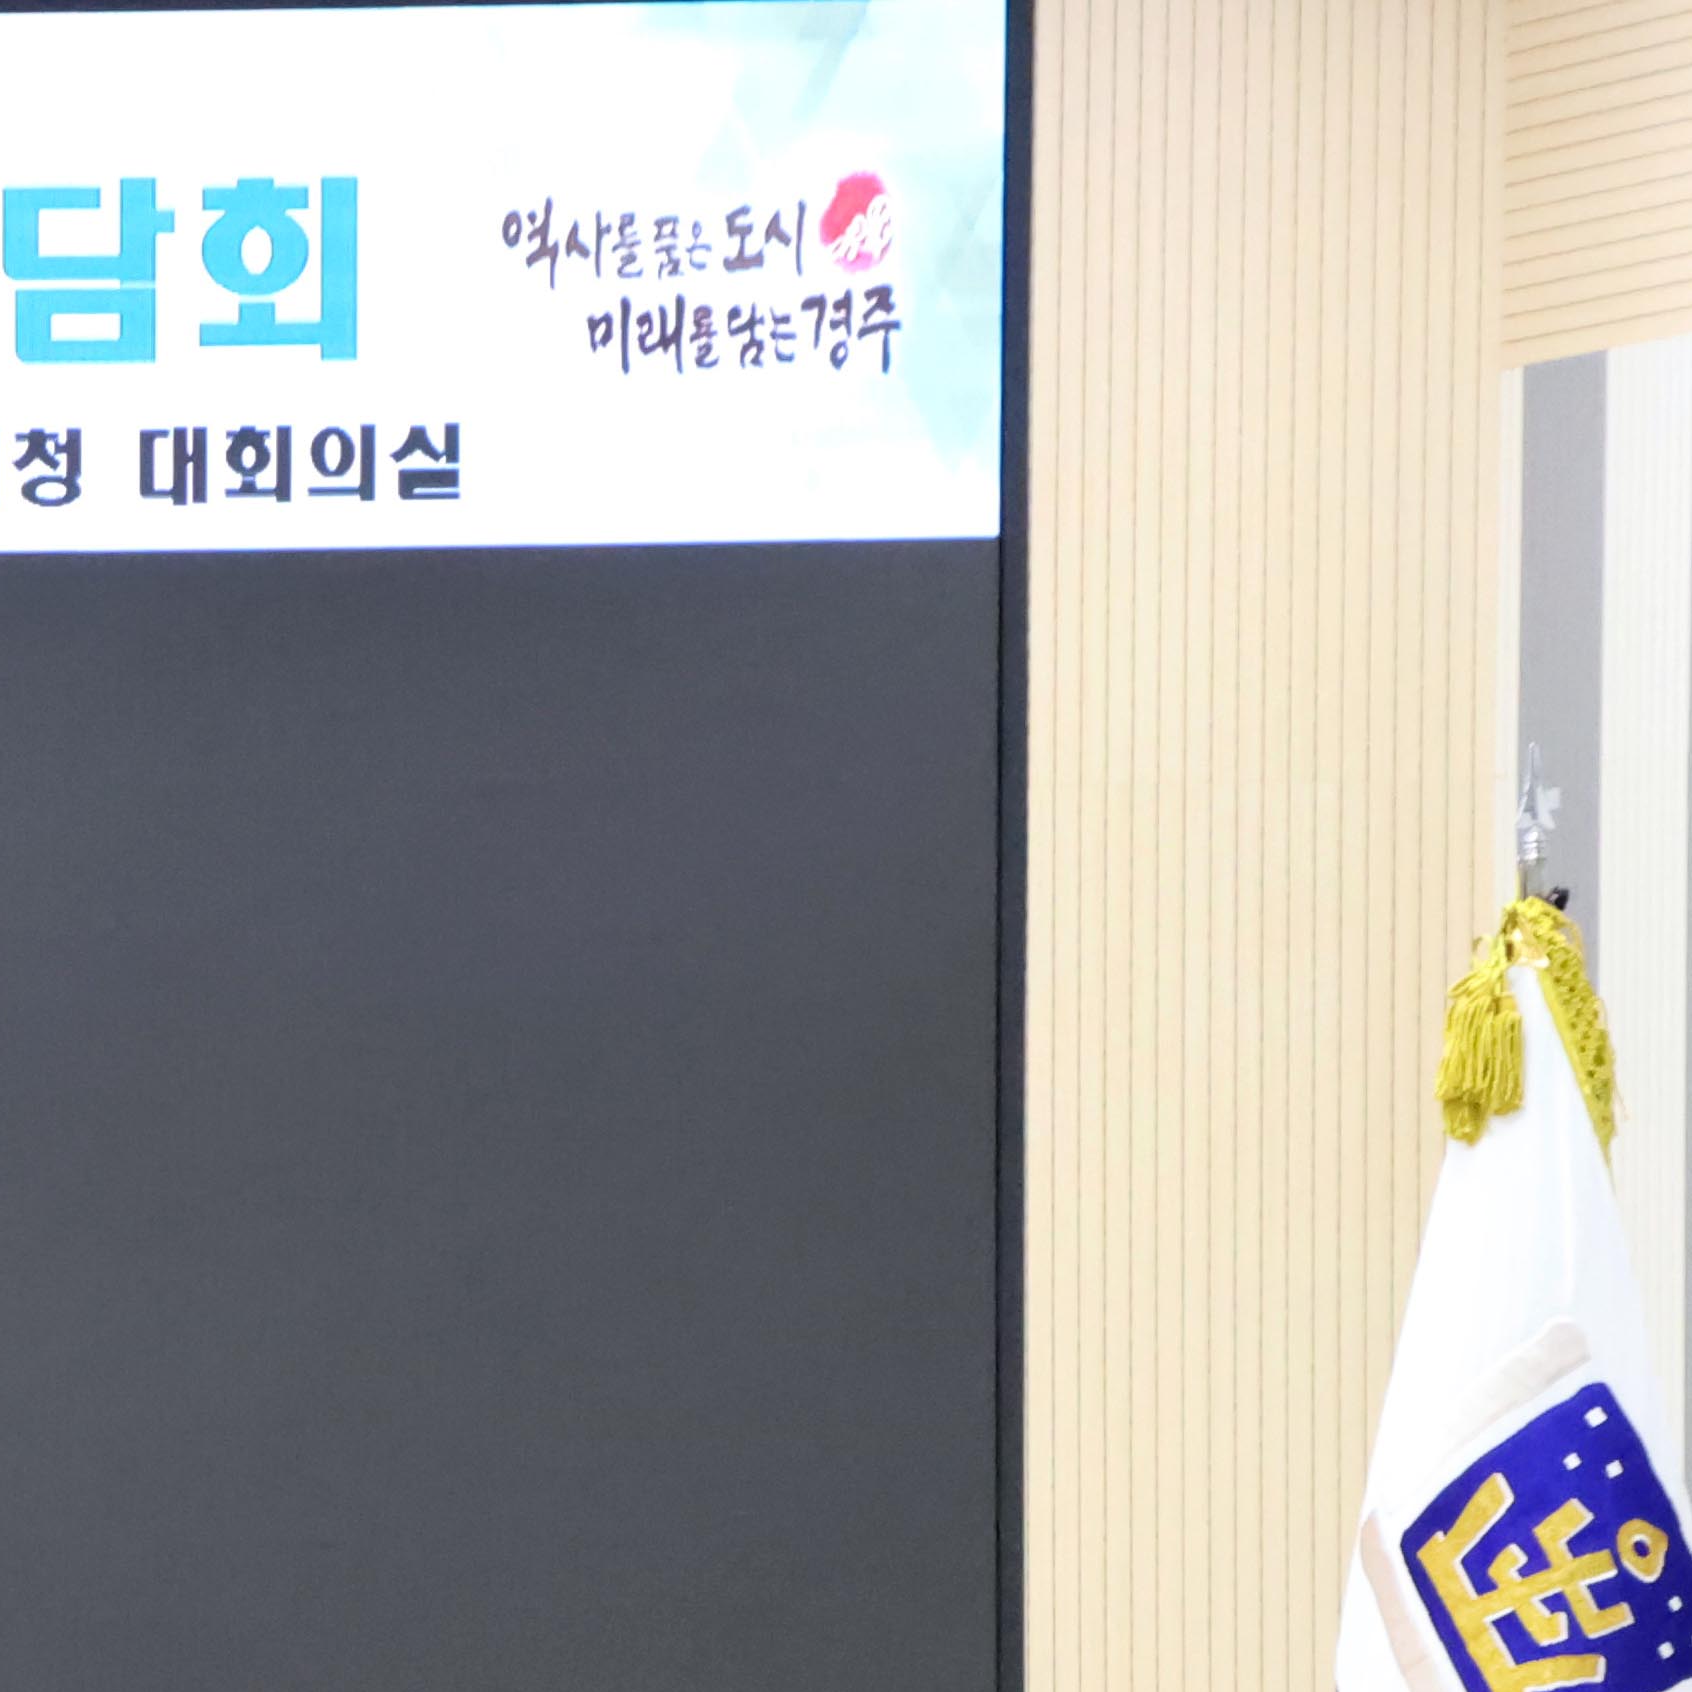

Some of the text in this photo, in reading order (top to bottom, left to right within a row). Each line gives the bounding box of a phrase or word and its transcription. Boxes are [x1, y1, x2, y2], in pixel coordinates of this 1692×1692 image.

[502, 196, 806, 290] 역사를 품은 도시
[586, 293, 719, 375] 미래를
[800, 283, 903, 375] 경주
[139, 422, 461, 506] 대회의실
